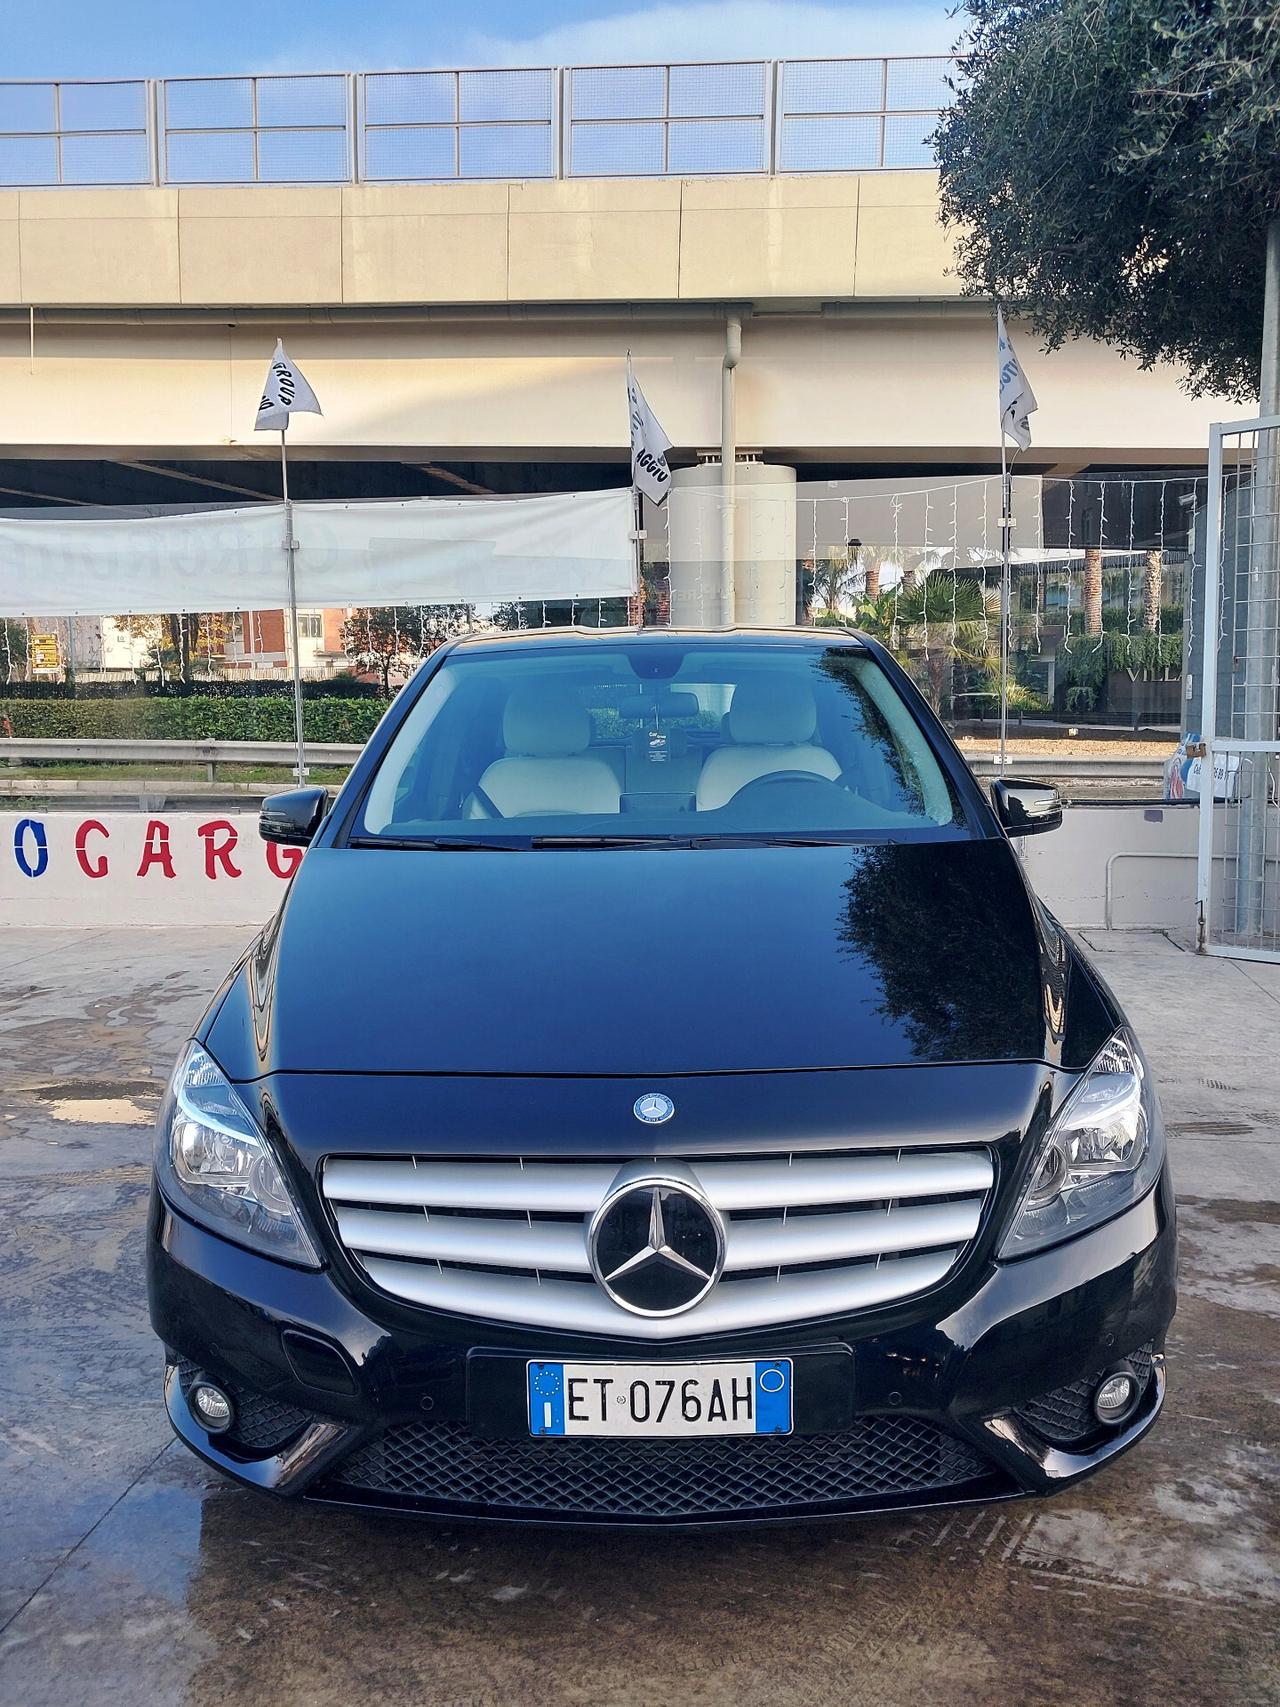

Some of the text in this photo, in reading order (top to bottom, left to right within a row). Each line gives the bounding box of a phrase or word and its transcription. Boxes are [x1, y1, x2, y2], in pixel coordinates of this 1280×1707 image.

[273, 362, 295, 406] GROUP
[568, 1377, 752, 1423] ET 076AH
